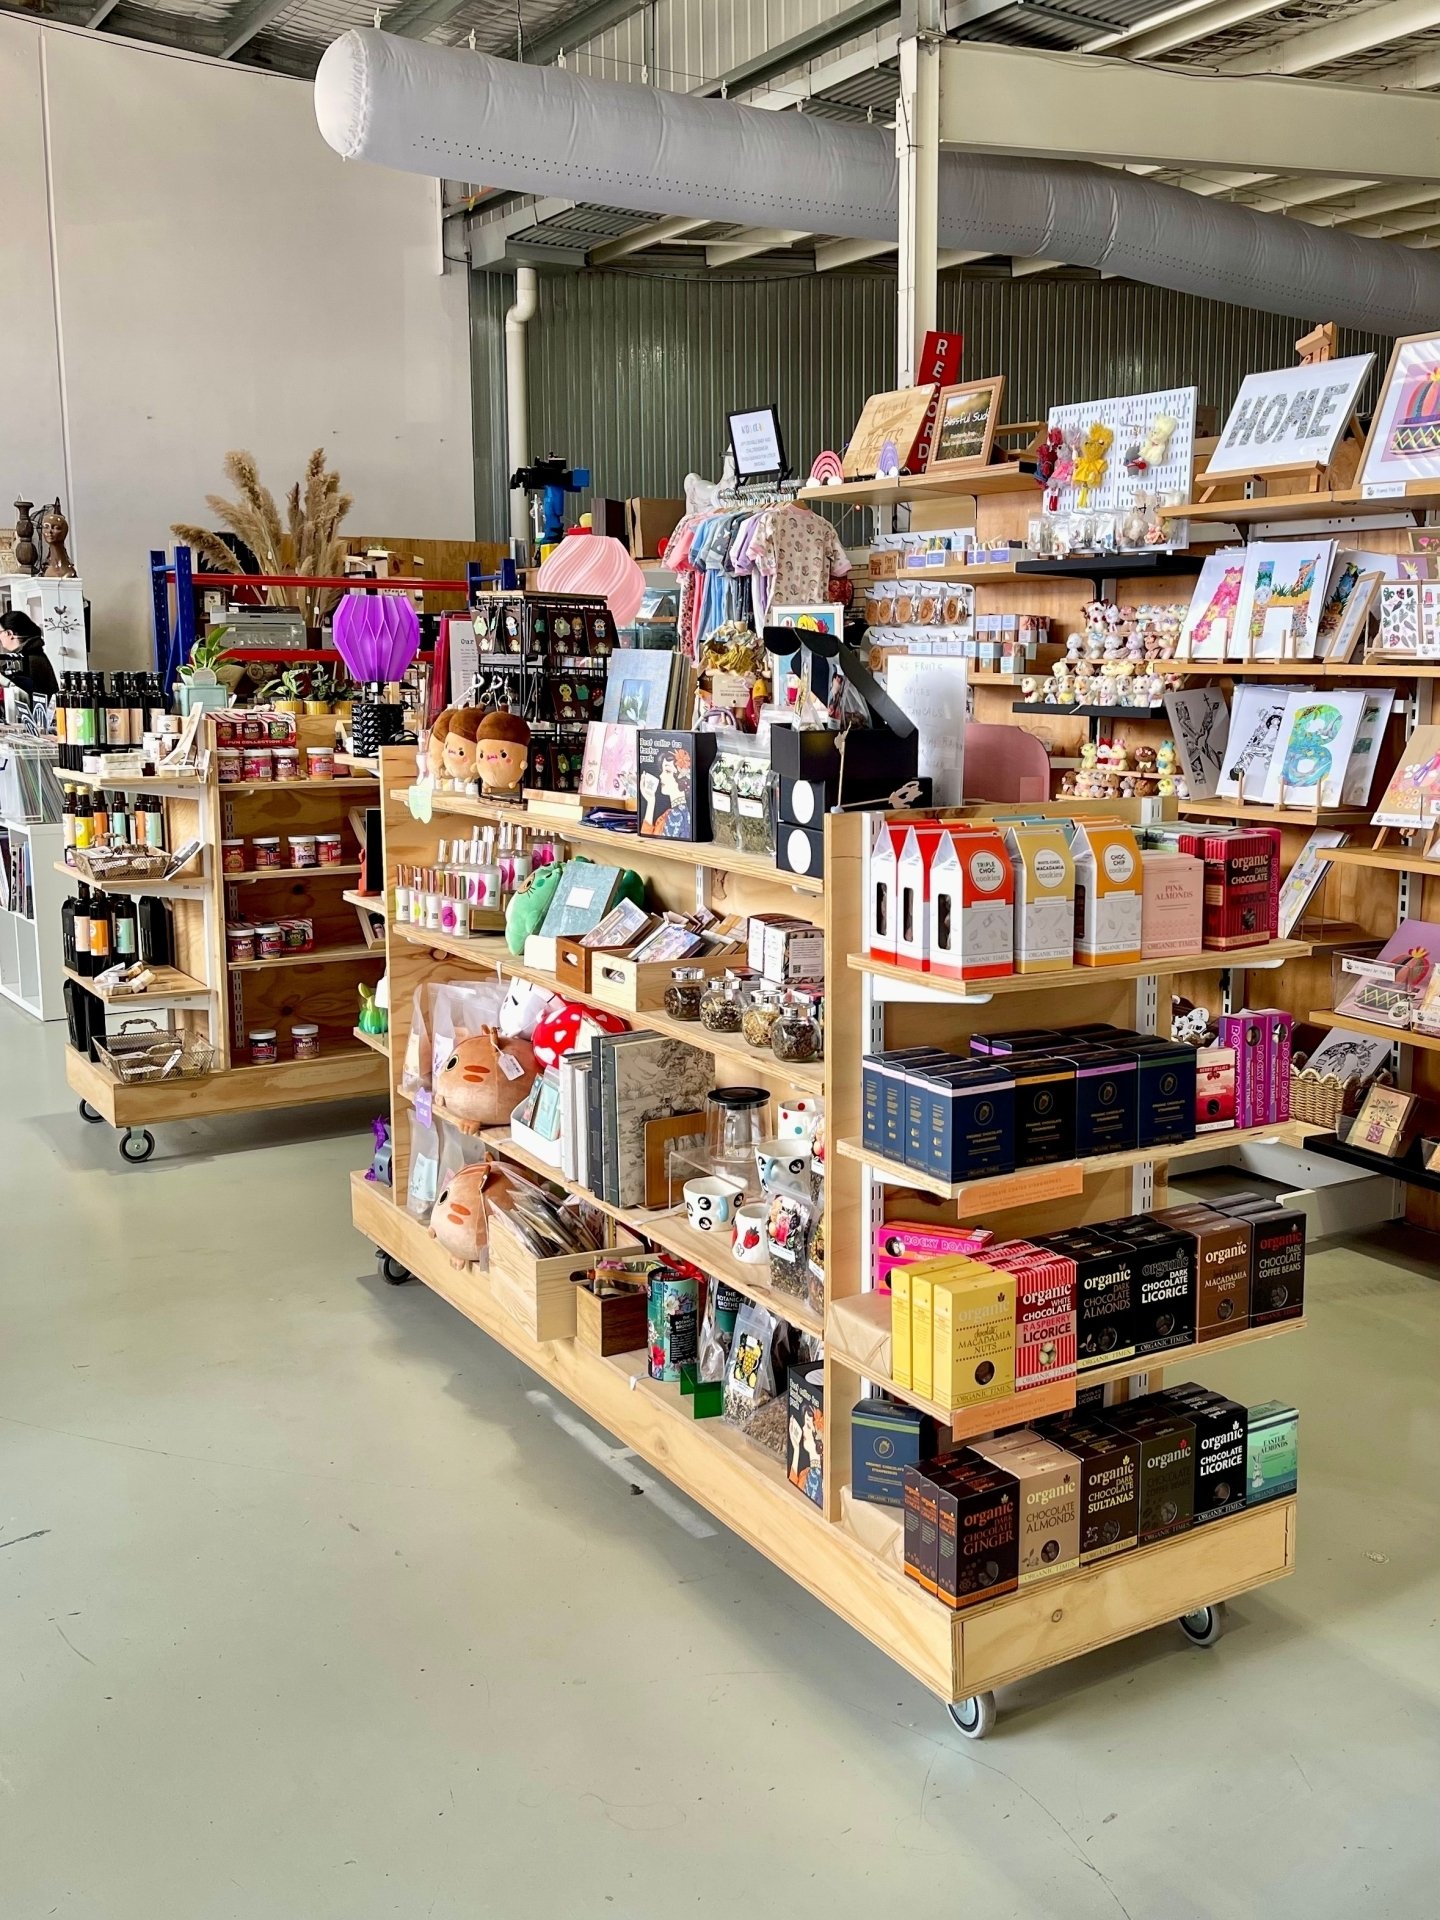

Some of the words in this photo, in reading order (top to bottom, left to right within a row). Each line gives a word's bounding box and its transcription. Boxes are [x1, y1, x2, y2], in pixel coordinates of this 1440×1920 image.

[1225, 383, 1350, 449] HOME
[976, 861, 996, 869] TRIPLE
[1110, 853, 1126, 861] CHOC
[1231, 854, 1268, 871] organic
[975, 874, 1001, 883] cookies
[1038, 872, 1063, 880] cookies
[1108, 866, 1131, 874] cookies
[1231, 873, 1268, 885] CHOCOLATE
[1254, 866, 1268, 875] DARK
[1155, 890, 1194, 901] ALMONDS
[1165, 883, 1184, 892] PINK
[1028, 951, 1054, 959] ORGANIC
[1055, 949, 1070, 957] TIMES
[1099, 943, 1120, 951] ORGANIC
[1146, 940, 1177, 951] ORGANIC
[1178, 939, 1199, 947] TIMES
[966, 956, 991, 964] ORGANIC
[992, 953, 1010, 961] TIMES
[903, 1235, 939, 1249] ROCKY
[1260, 1232, 1302, 1251] organic
[1285, 1243, 1302, 1254] DARK
[1205, 1243, 1247, 1264] organic
[1259, 1252, 1301, 1269] CHOCOLATE
[1141, 1256, 1189, 1278] organic
[1170, 1268, 1188, 1280] DARK
[1259, 1266, 1281, 1279] COFFEE
[1281, 1262, 1301, 1274] BEANS
[1083, 1269, 1131, 1291] organic
[1113, 1281, 1130, 1293] DARK
[1141, 1276, 1188, 1292] CHOCOLATE
[1204, 1270, 1247, 1288] MACADAMIA
[1217, 1281, 1236, 1292] NUTS
[1022, 1283, 1071, 1306] organic
[1051, 1296, 1071, 1307] WHITE
[1083, 1290, 1130, 1308] CHOCOLATE
[1141, 1284, 1188, 1304] LICORICE
[958, 1302, 1010, 1323] organic
[1022, 1303, 1071, 1322] CHOCOLATE
[1083, 1299, 1131, 1319] ALMONDS
[1257, 1311, 1283, 1322] ORGANIC
[1283, 1306, 1302, 1316] TIMES
[1022, 1313, 1071, 1332] RASPBERRY
[958, 1331, 1011, 1349] MACADAMIA
[1022, 1322, 1071, 1344] LICORICE
[974, 1342, 997, 1355] NUTS
[1139, 1340, 1168, 1352] ORGANIC
[1169, 1334, 1189, 1345] TIMES
[1081, 1352, 1110, 1366] ORGANIC
[1111, 1348, 1132, 1360] TIMES
[1022, 1372, 1051, 1384] ORGANIC
[1053, 1366, 1074, 1377] TIMES
[956, 1390, 988, 1403] ORGANIC
[990, 1384, 1012, 1396] TIMES
[1201, 1427, 1243, 1450] organic
[1261, 1441, 1288, 1454] ALMONDS
[1263, 1435, 1286, 1447] EASTER
[1147, 1446, 1191, 1469] organic
[1200, 1445, 1243, 1466] CHOCOLATE
[1088, 1462, 1134, 1486] organic
[1200, 1454, 1243, 1477] LICORICE
[1116, 1474, 1134, 1486] DARK
[1026, 1481, 1076, 1505] organic
[1088, 1482, 1134, 1502] CHOCOLATE
[1250, 1489, 1275, 1501] ORGANIC
[1277, 1481, 1295, 1494] TIMES
[1088, 1491, 1134, 1514] SULTANAS
[1198, 1508, 1223, 1522] ORGANIC
[1225, 1501, 1244, 1514] TIMES
[964, 1501, 1014, 1529] organic
[994, 1514, 1013, 1528] DARK
[1026, 1501, 1075, 1523] CHOCOLATE
[1026, 1511, 1076, 1534] ALMONDS
[963, 1524, 1013, 1544] CHOCOLATE
[1143, 1529, 1170, 1542] ORGANIC
[1171, 1522, 1191, 1534] TIMES
[963, 1530, 1015, 1556] GINGER
[1086, 1547, 1113, 1560] ORGANIC
[1114, 1538, 1134, 1550] TIMES
[1022, 1567, 1053, 1582] ORGANIC
[1054, 1560, 1077, 1574] TIMES
